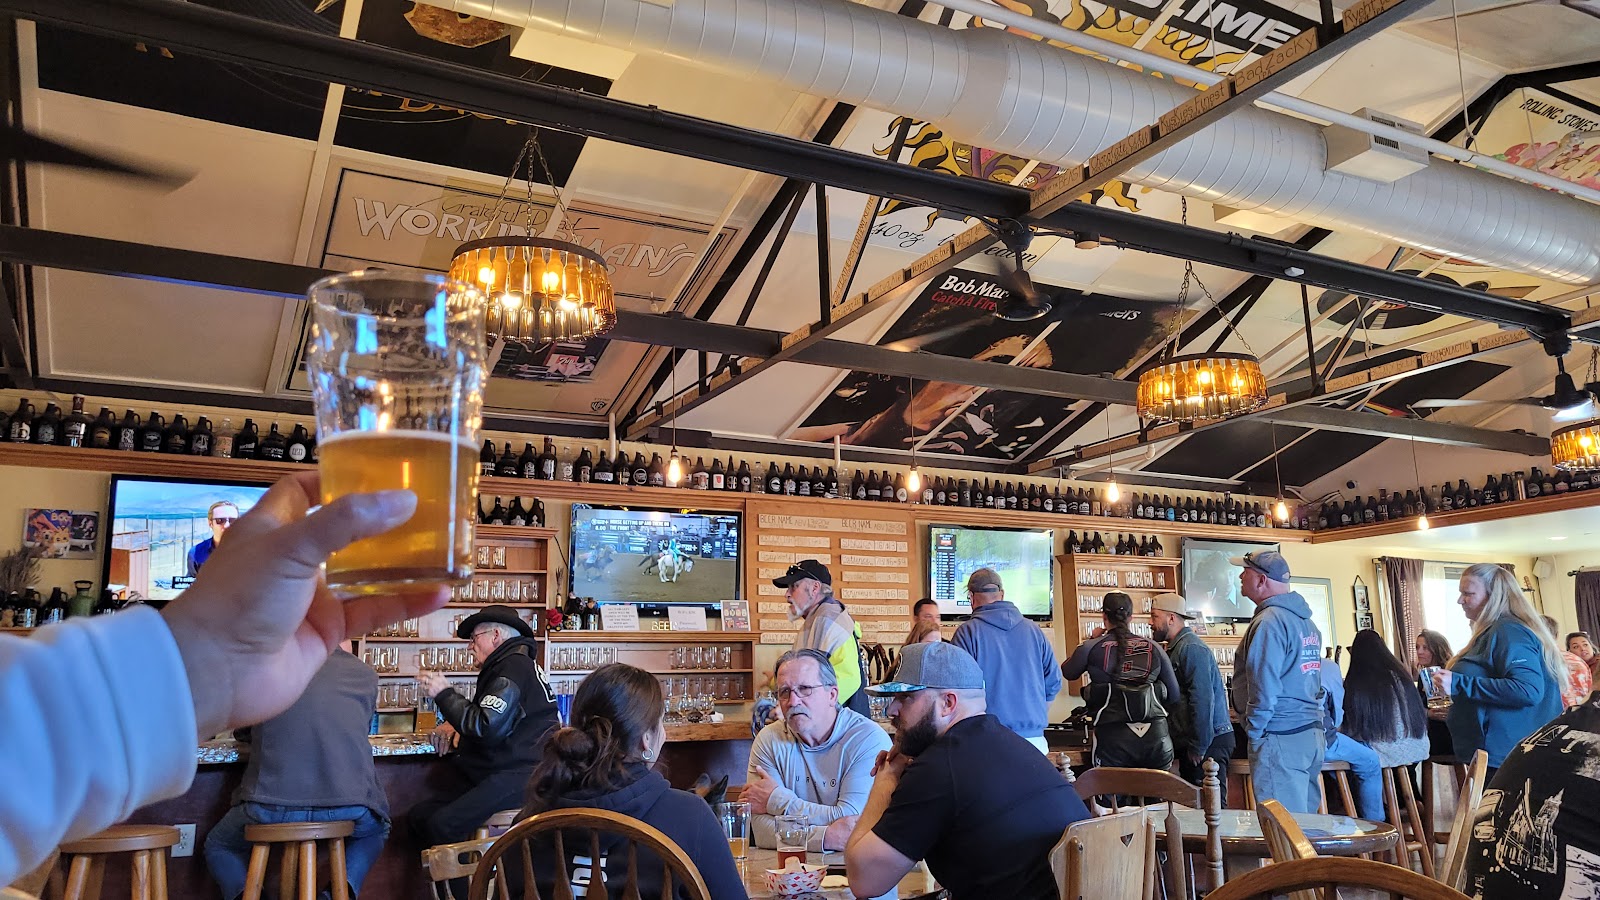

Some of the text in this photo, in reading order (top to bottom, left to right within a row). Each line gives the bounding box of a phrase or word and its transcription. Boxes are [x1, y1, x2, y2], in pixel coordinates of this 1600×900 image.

[1519, 98, 1599, 132] ROLLING STONES
[939, 275, 975, 294] Bob
[931, 291, 997, 311] Catch A Fire
[760, 515, 776, 525] BEER
[777, 515, 793, 525] NAME
[480, 694, 508, 714] 2001
